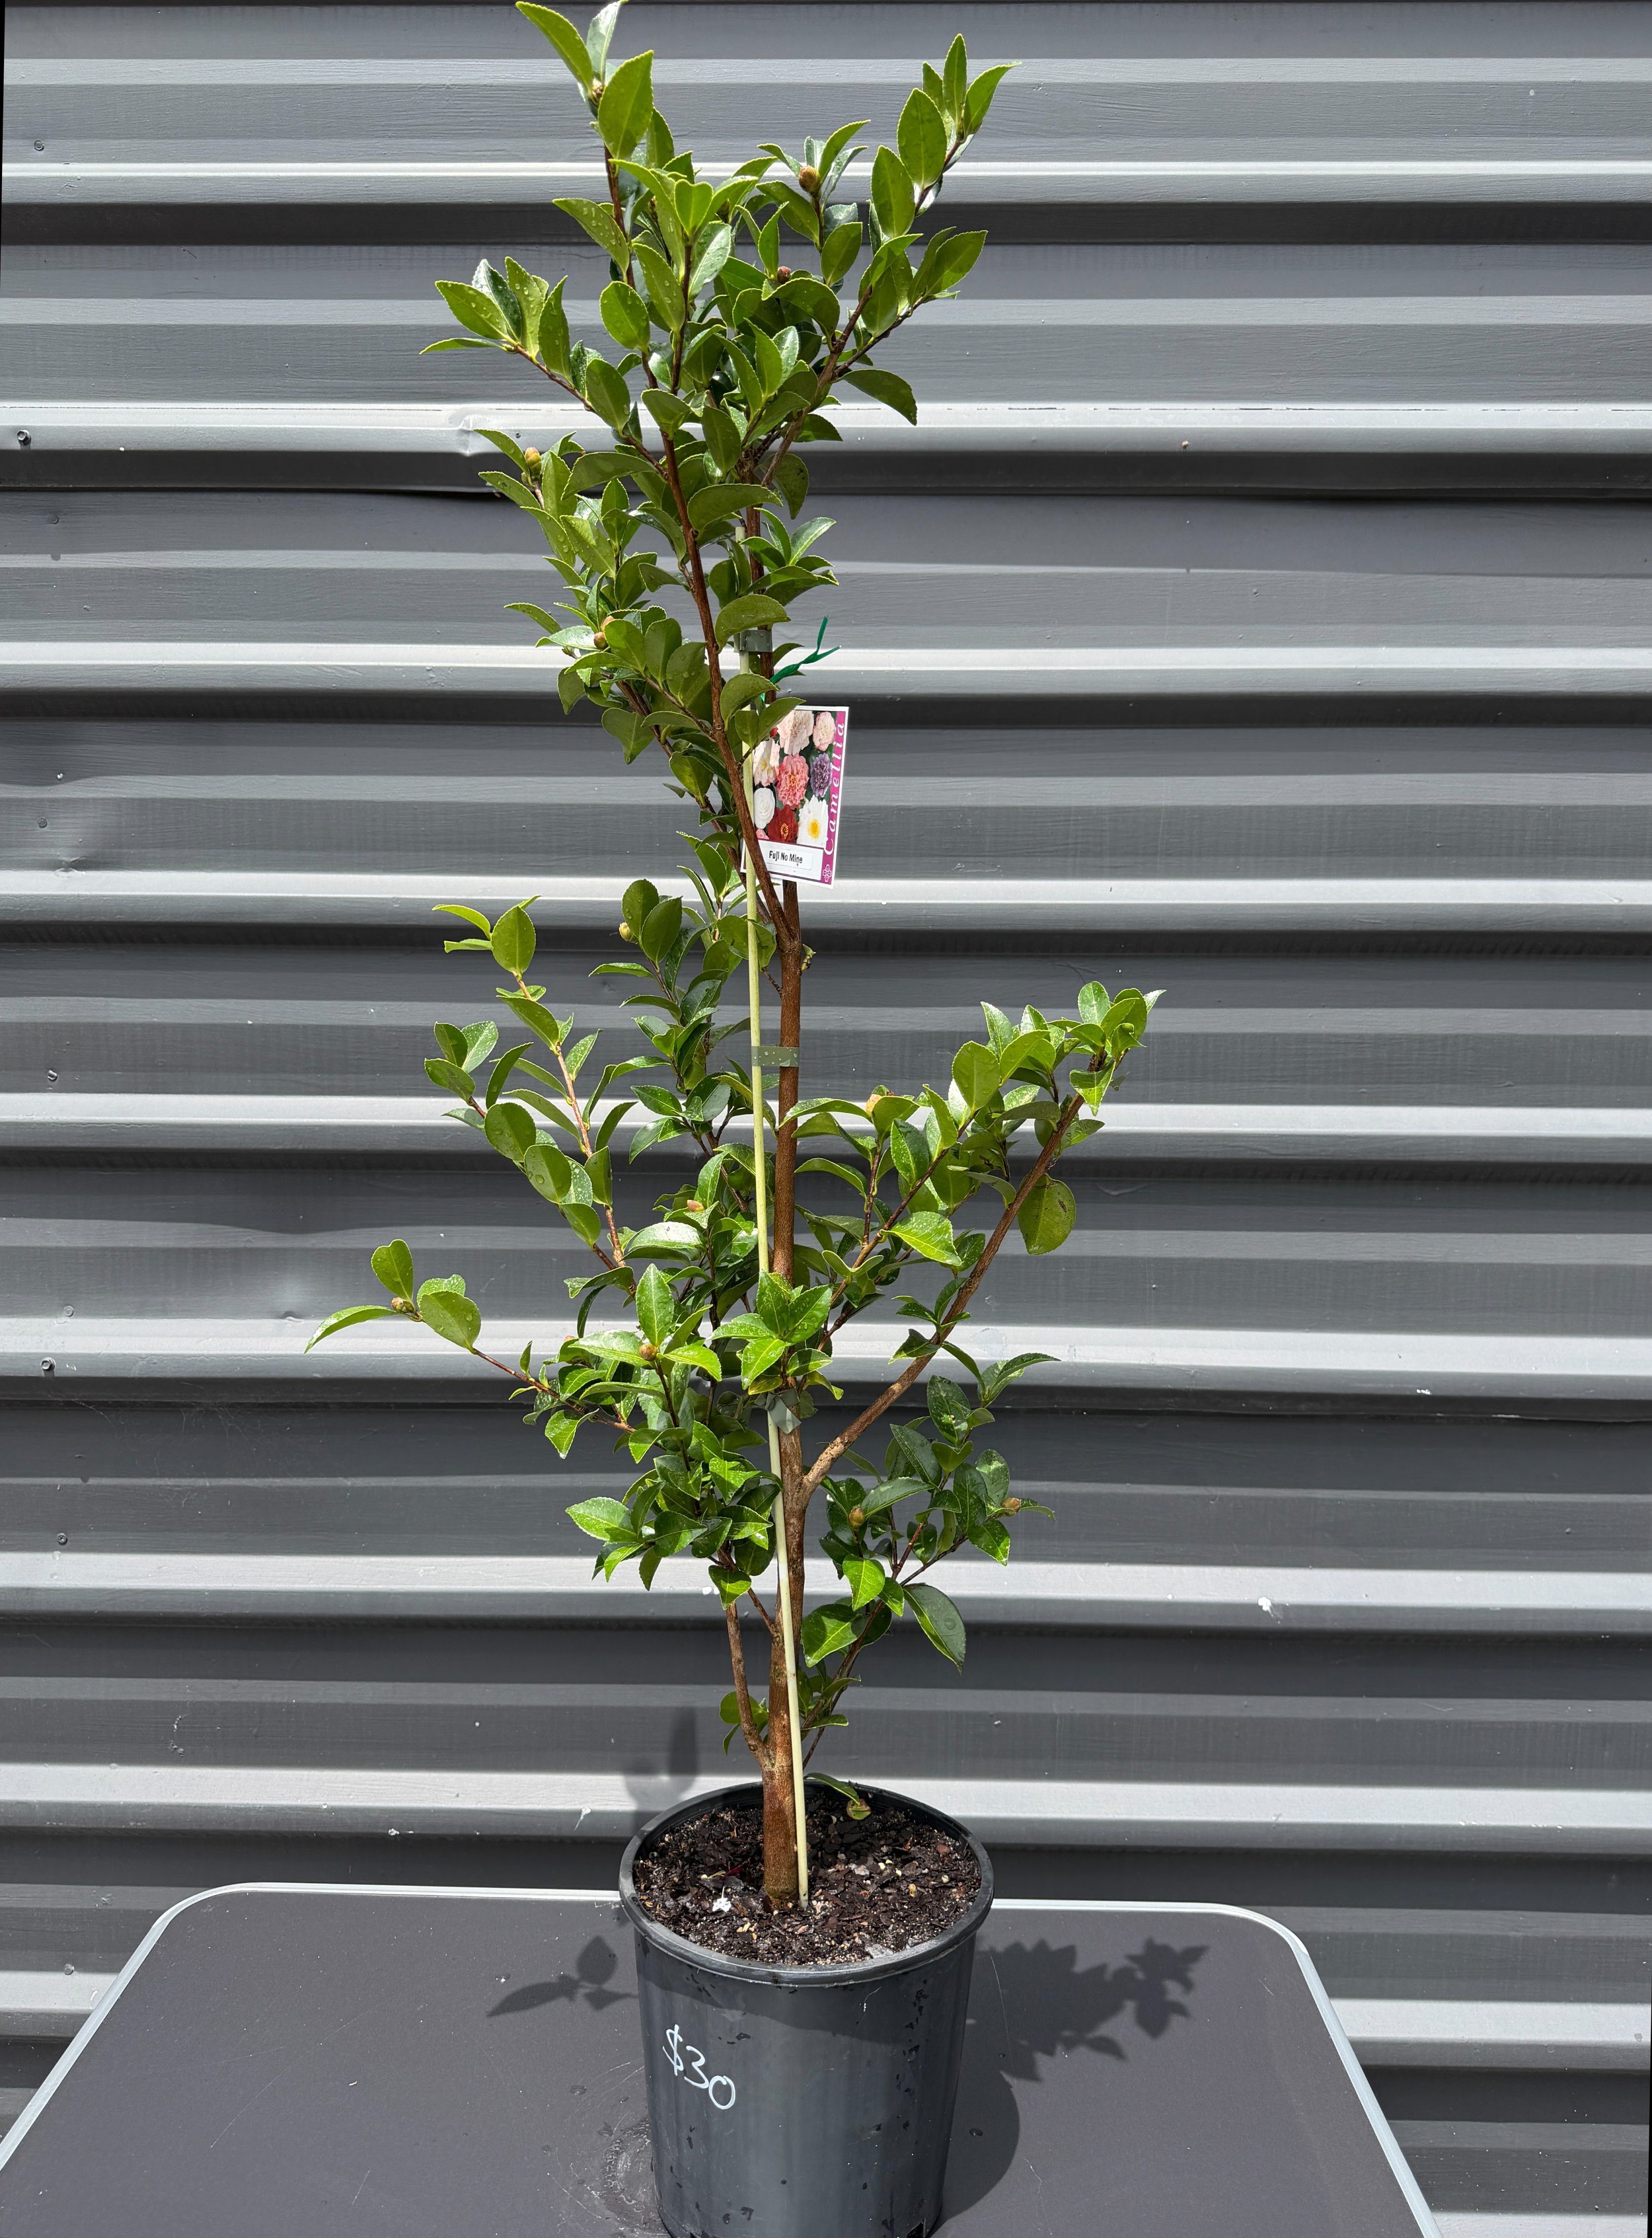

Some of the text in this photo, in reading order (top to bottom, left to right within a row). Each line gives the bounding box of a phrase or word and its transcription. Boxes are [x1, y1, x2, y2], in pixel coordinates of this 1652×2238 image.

[824, 723, 845, 855] Camellia
[769, 850, 803, 864] Fuji No Mine
[662, 2024, 735, 2110] $30
